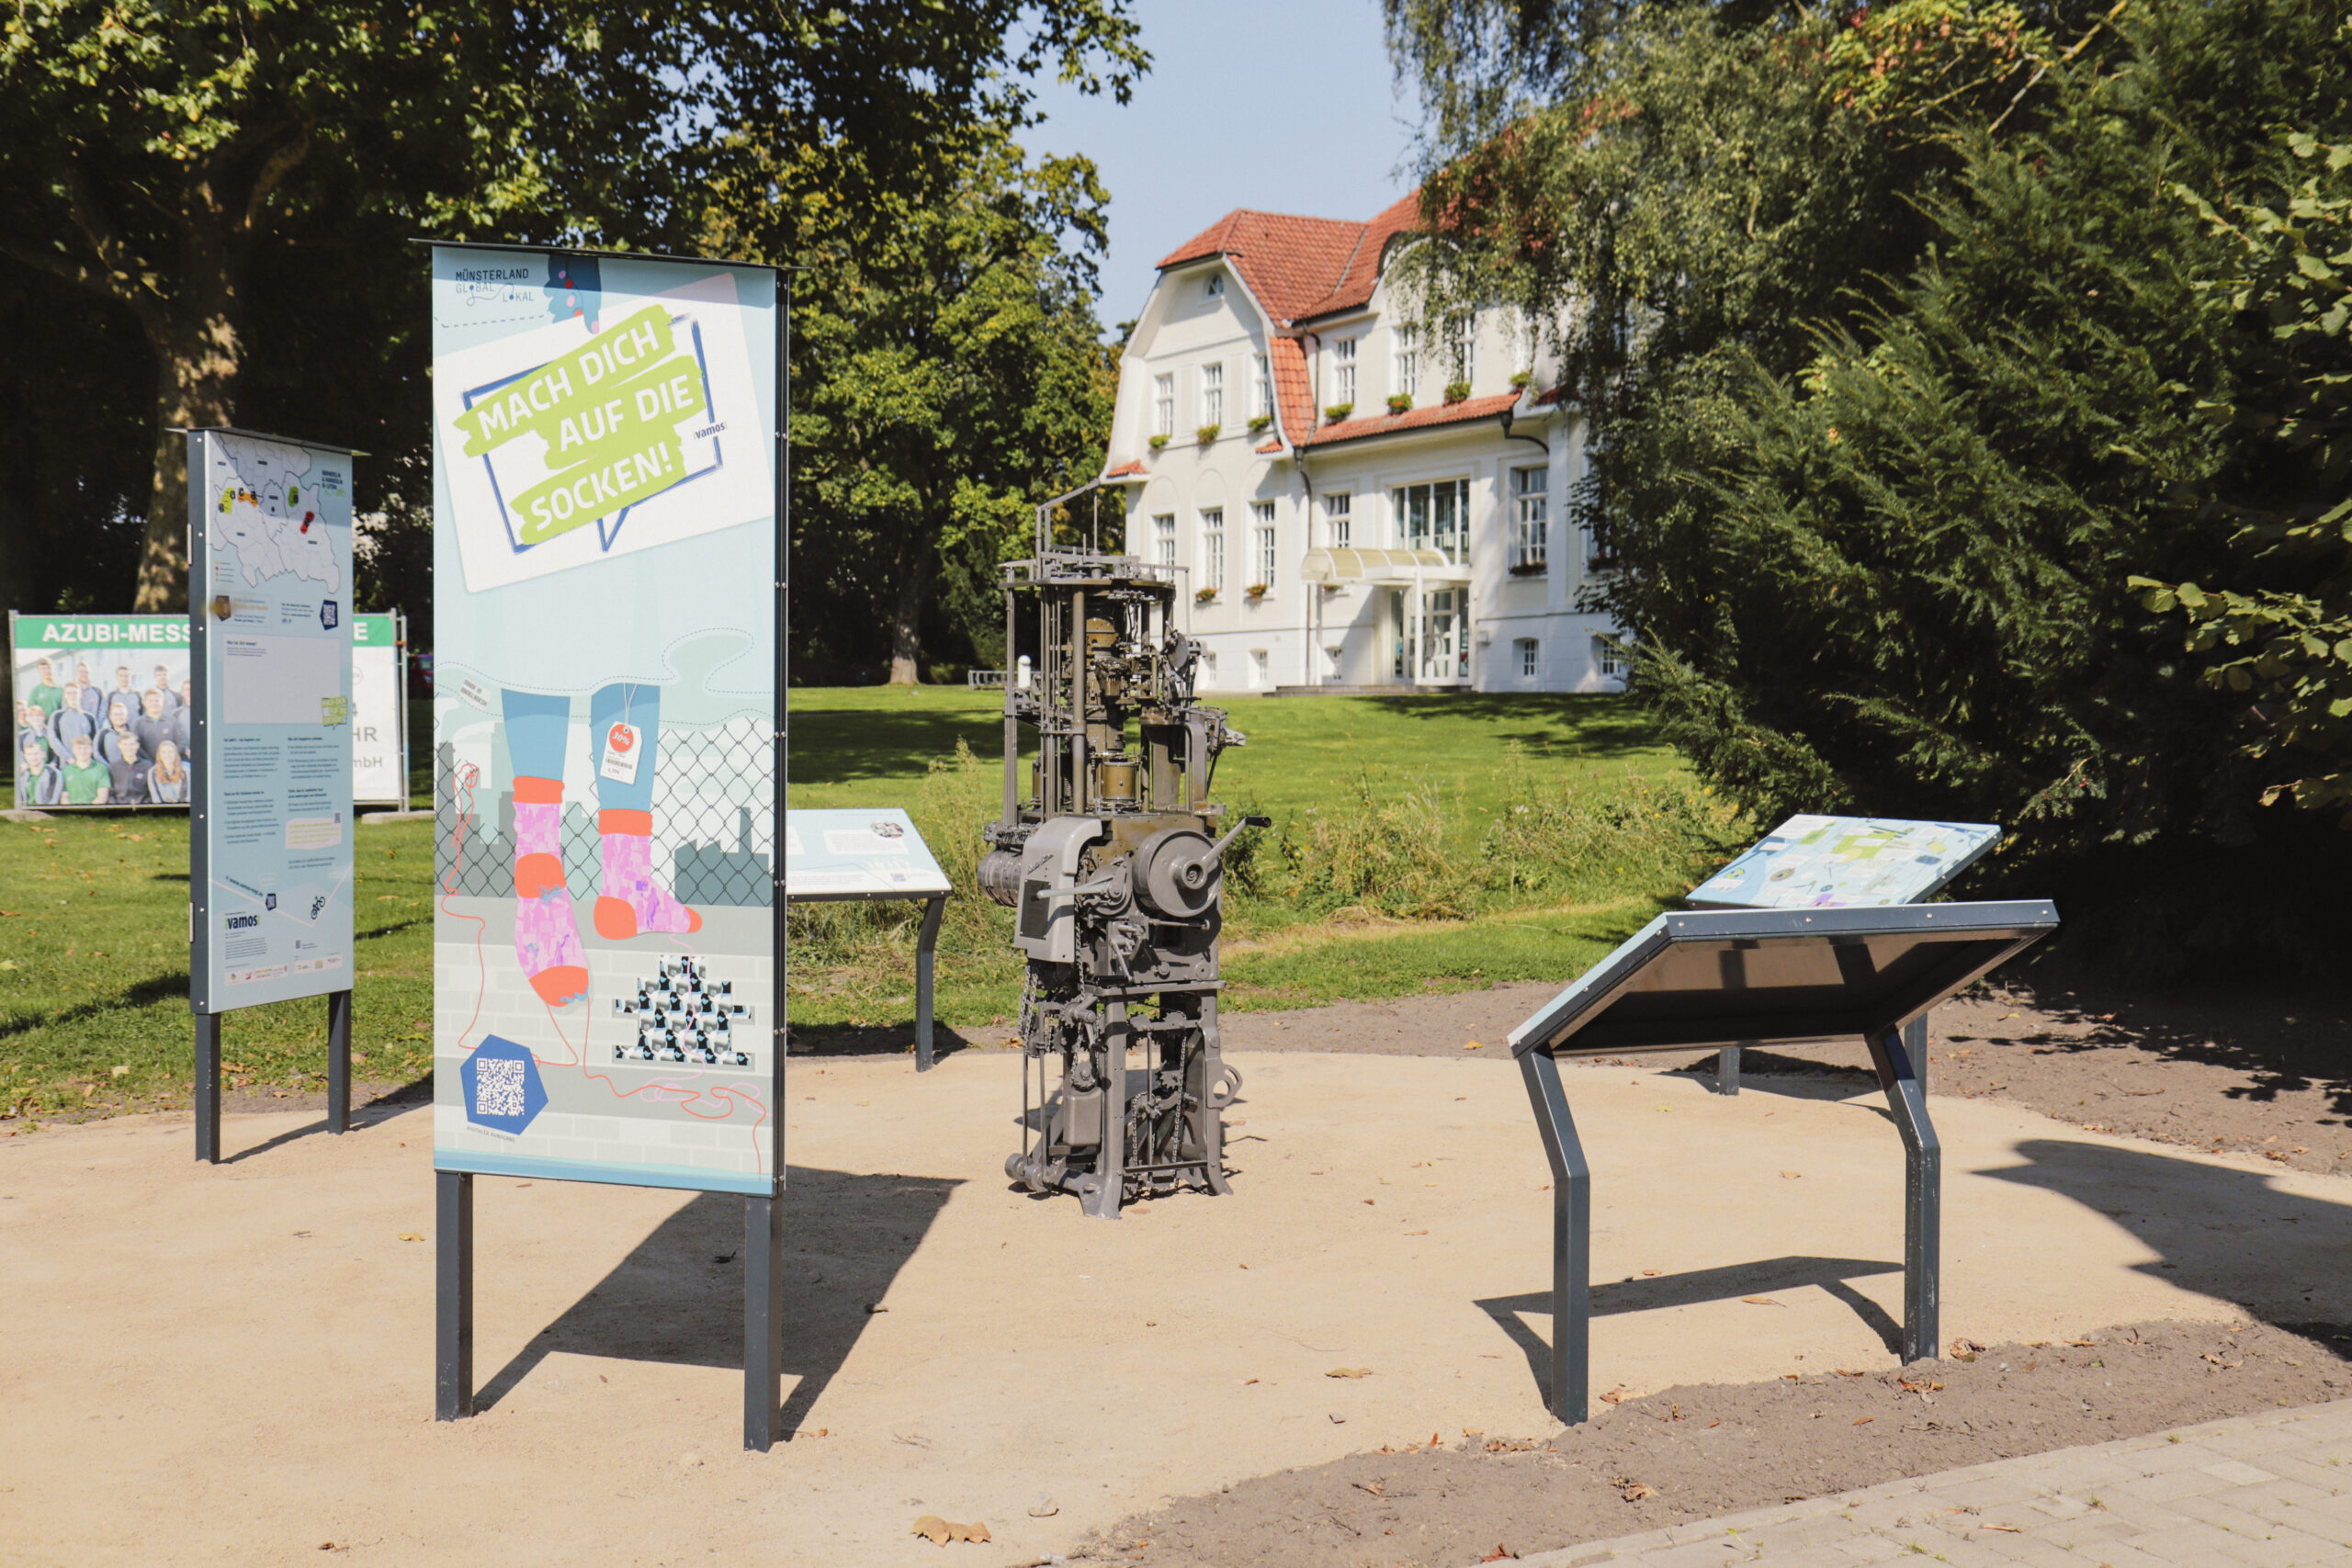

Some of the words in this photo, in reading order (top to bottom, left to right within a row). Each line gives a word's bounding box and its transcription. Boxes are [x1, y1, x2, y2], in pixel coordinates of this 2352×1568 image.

[456, 268, 529, 281] MÜNSTERLAND
[477, 367, 573, 441] MACH
[578, 320, 660, 385] DICH
[560, 399, 624, 451] AUF
[635, 374, 694, 423] DIE
[695, 422, 726, 439] vamos
[530, 441, 673, 531] SOCKEN!
[612, 731, 630, 746] 30%
[227, 915, 257, 930] vamos
